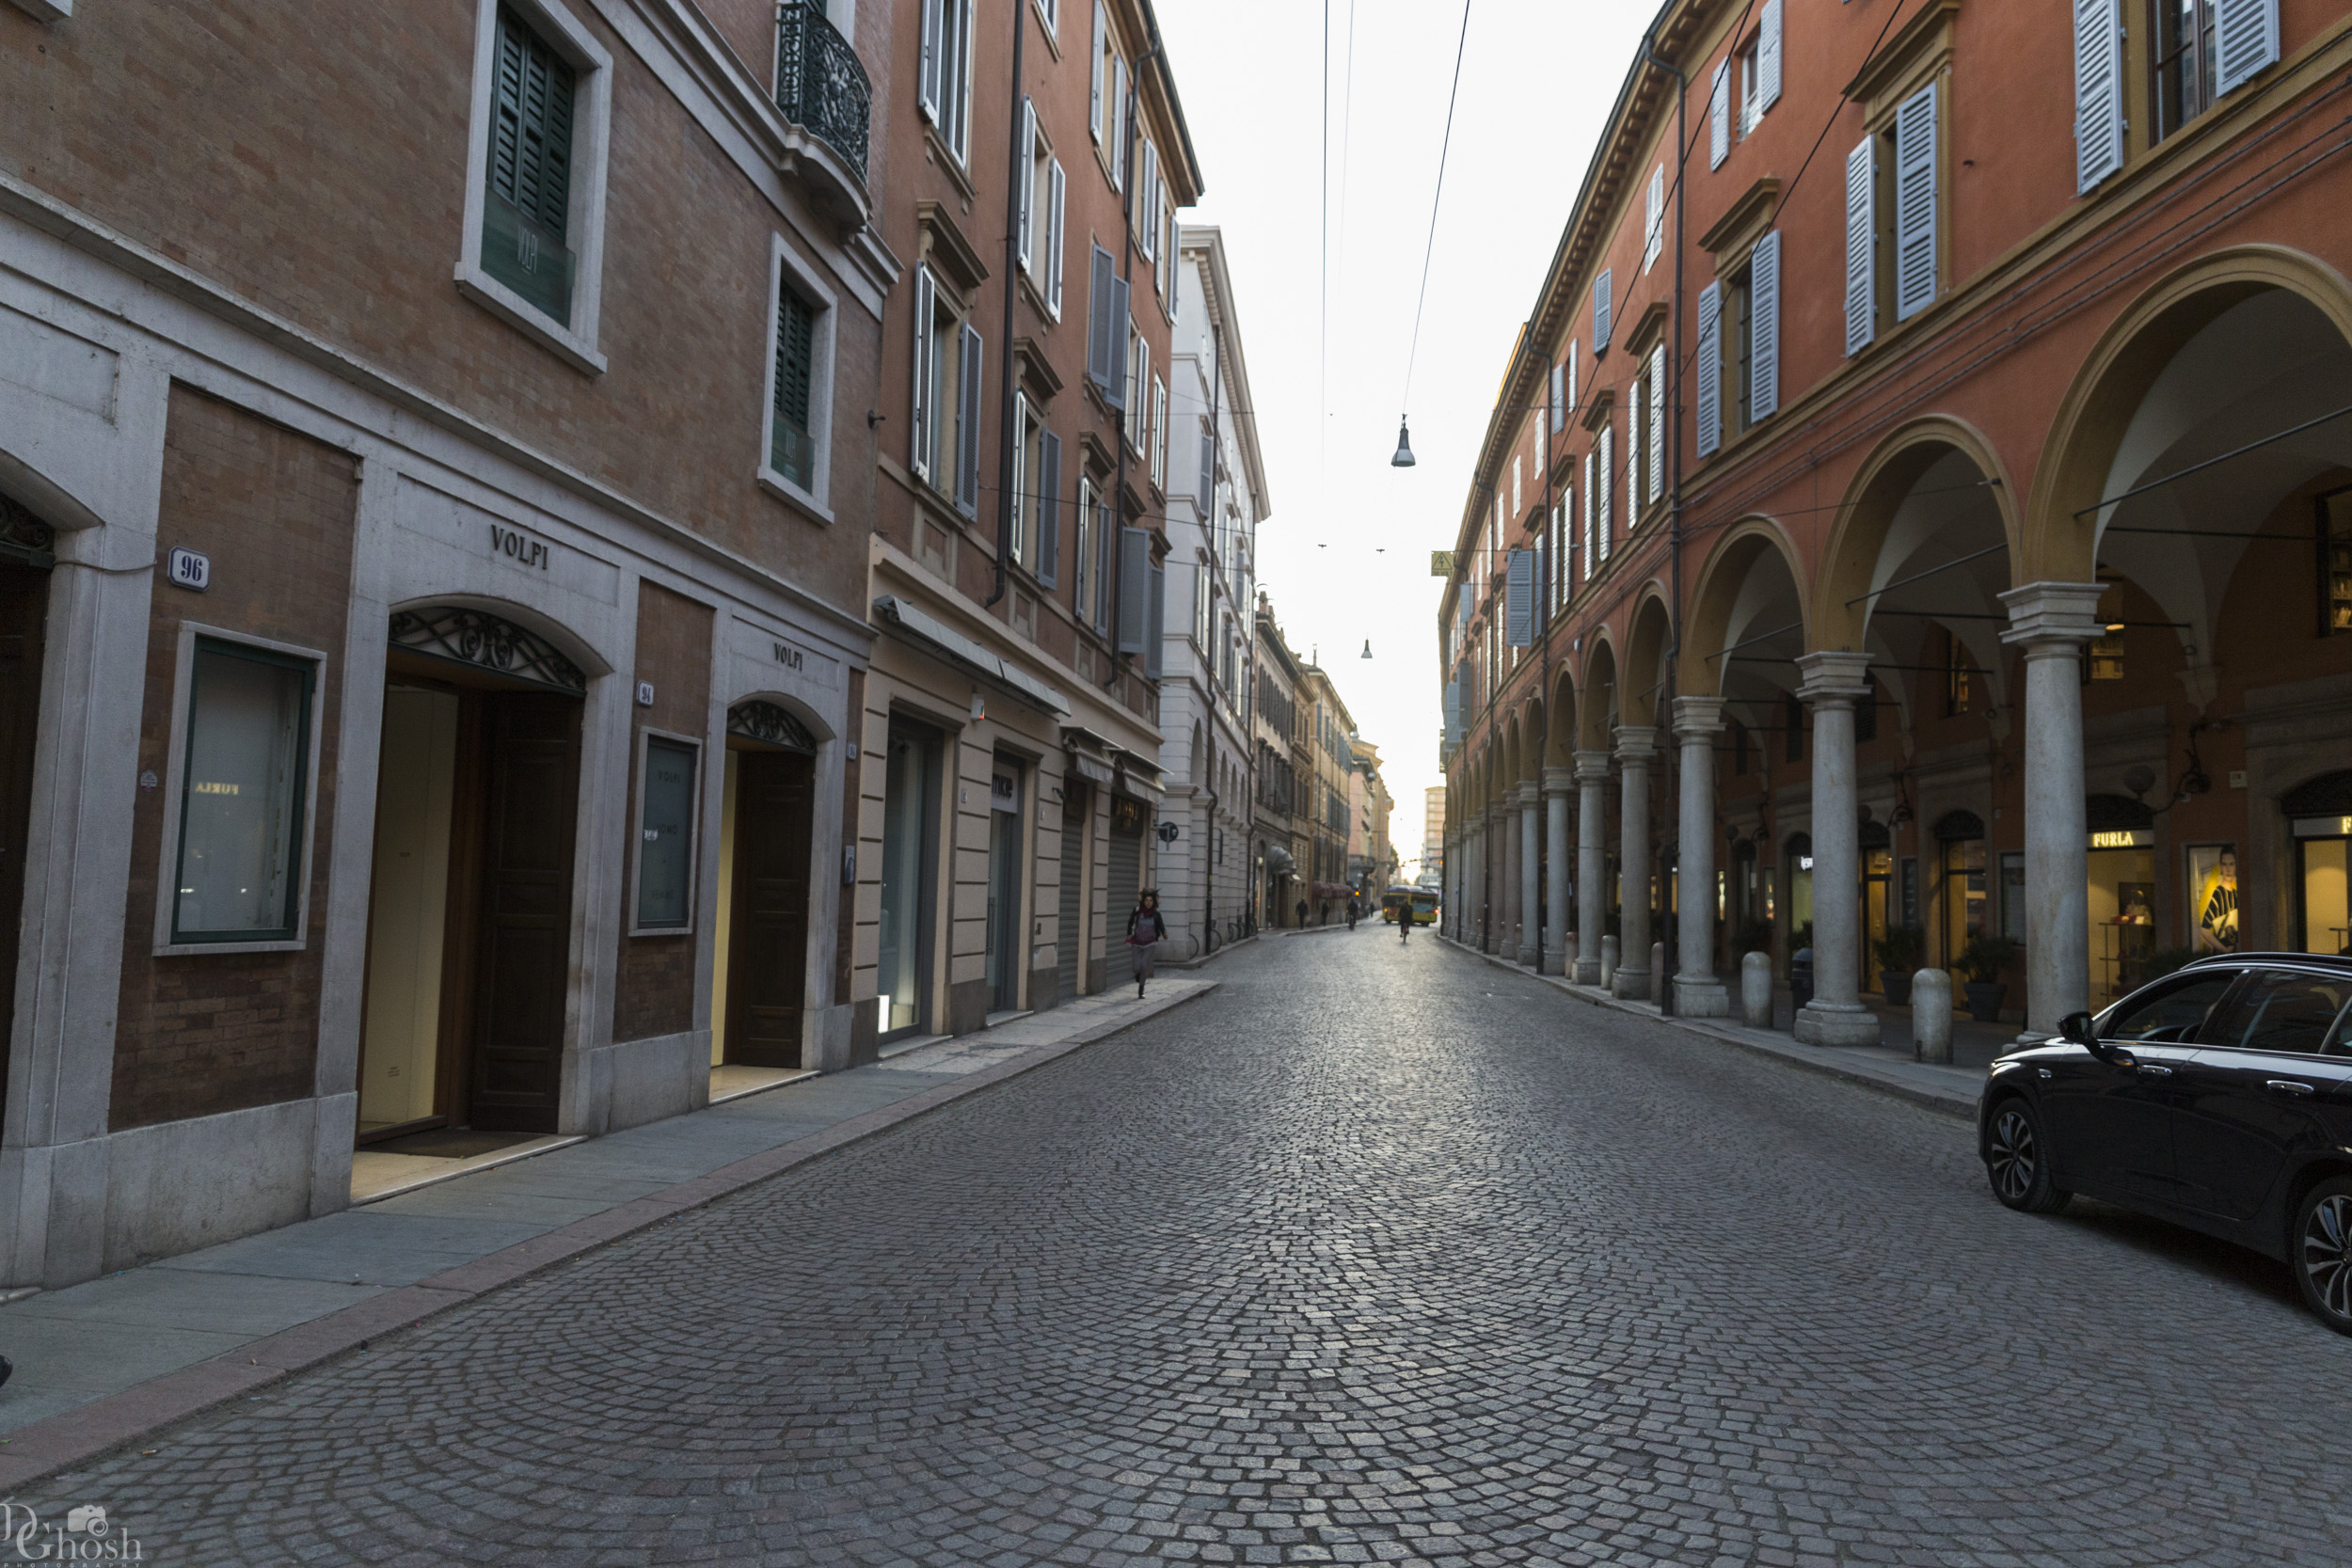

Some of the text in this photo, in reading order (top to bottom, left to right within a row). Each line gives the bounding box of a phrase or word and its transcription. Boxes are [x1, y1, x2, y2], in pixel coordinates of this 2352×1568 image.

[490, 524, 548, 570] VOLPI
[181, 555, 202, 581] 96
[774, 642, 803, 672] VOLPI
[642, 686, 651, 703] 94
[2092, 831, 2135, 847] FURLA
